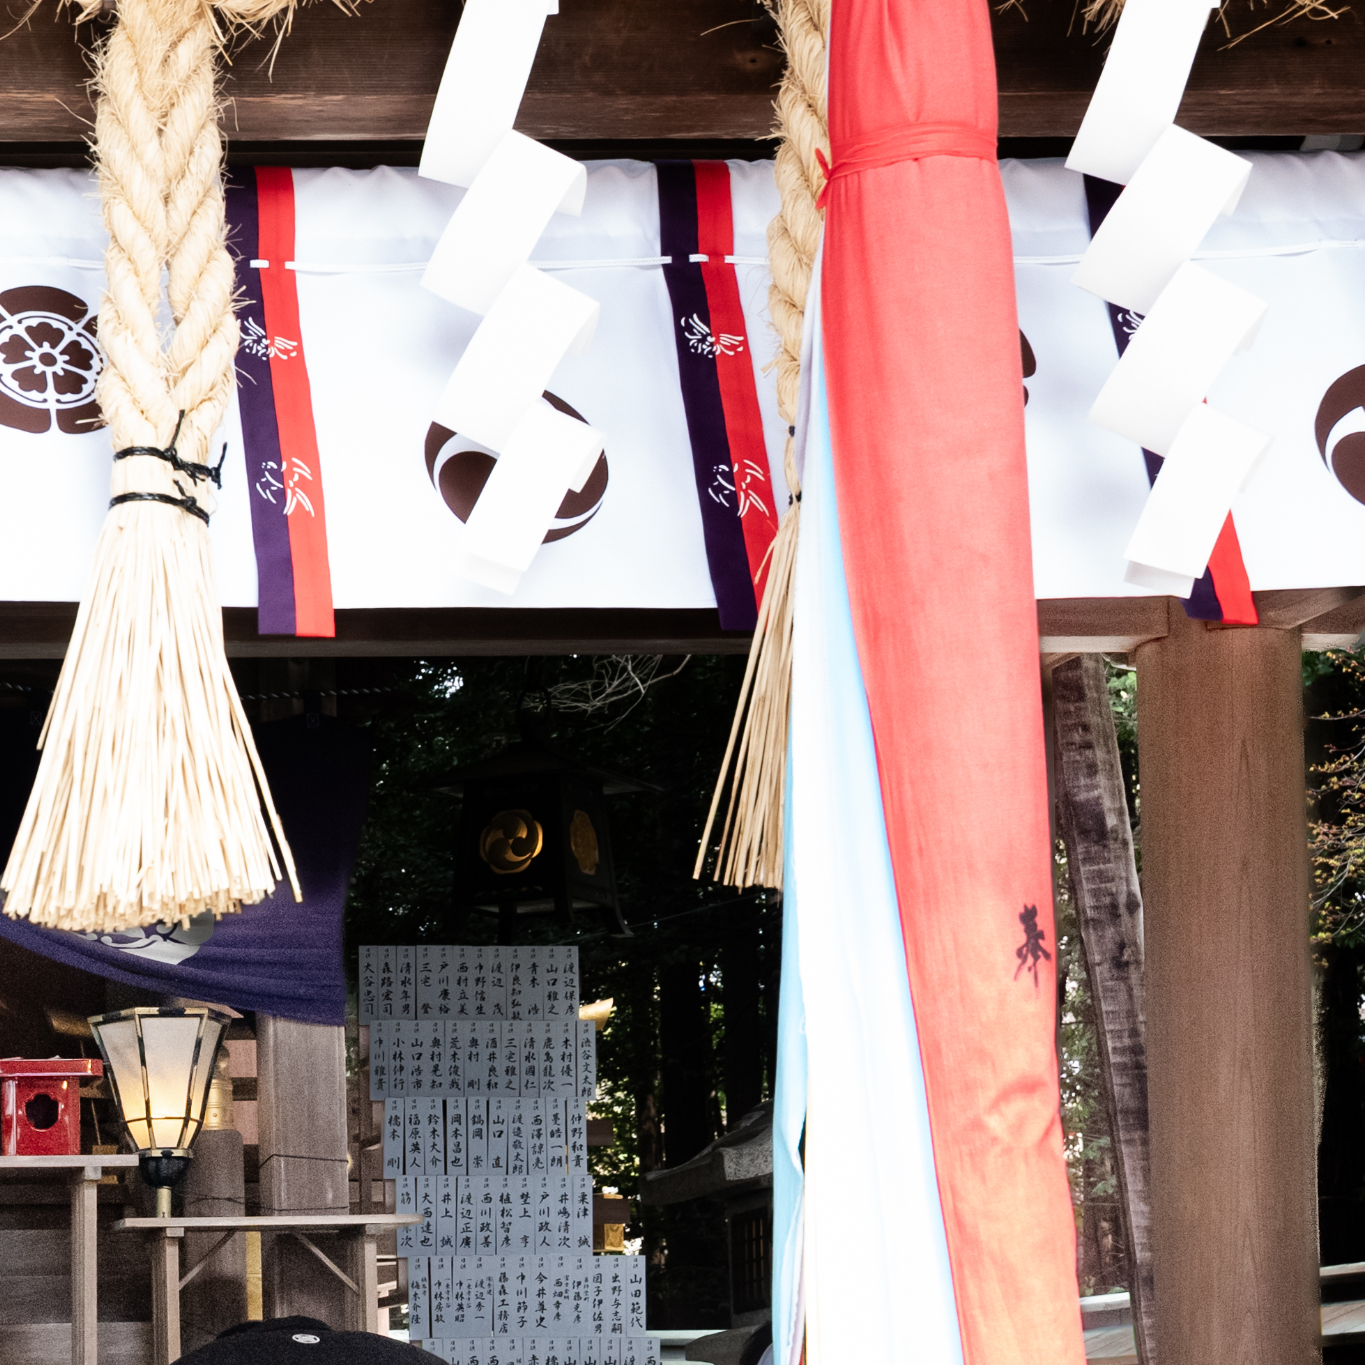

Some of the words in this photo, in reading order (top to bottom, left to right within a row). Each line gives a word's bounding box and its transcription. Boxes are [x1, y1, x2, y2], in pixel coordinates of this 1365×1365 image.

[363, 962, 375, 1015] 大谷忠司
[427, 1114, 442, 1168] 鈴木大介
